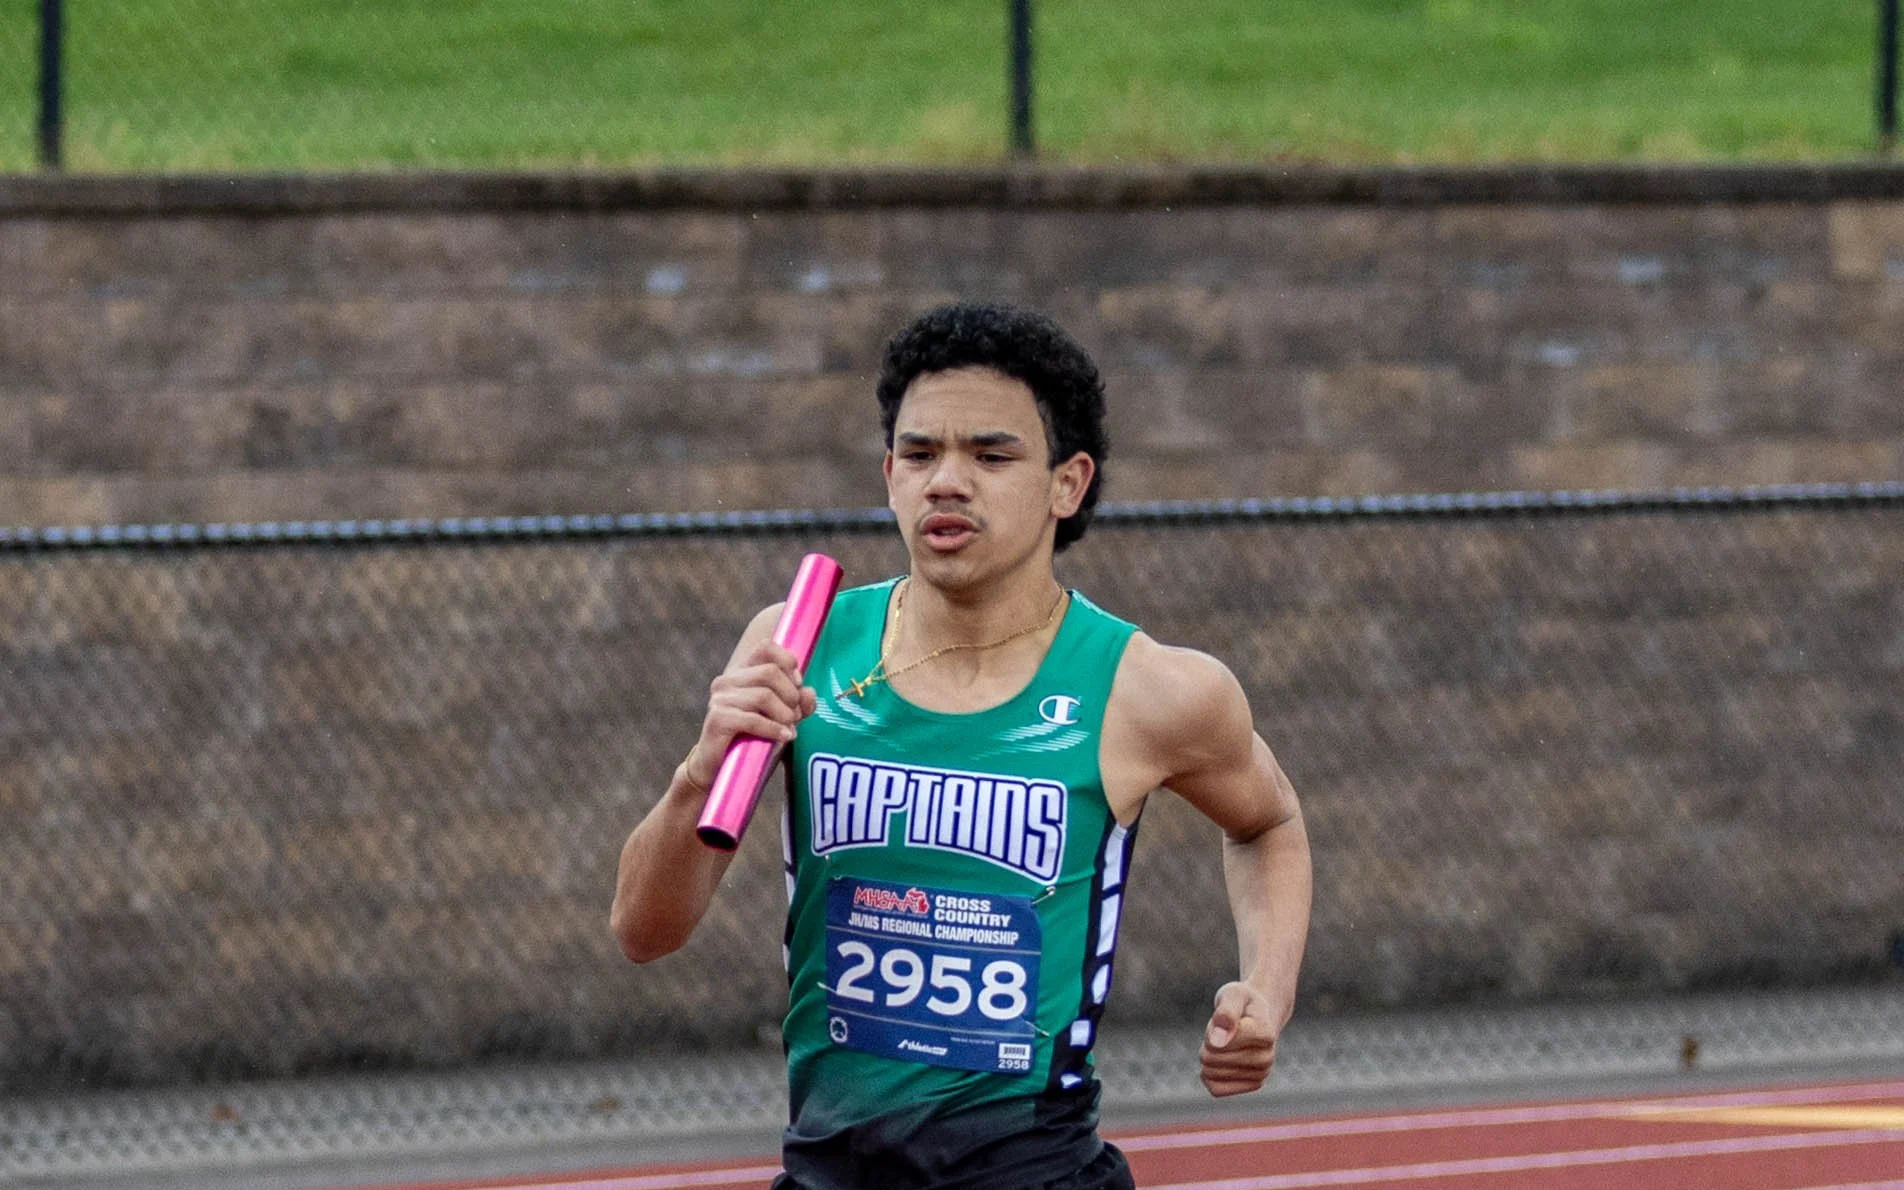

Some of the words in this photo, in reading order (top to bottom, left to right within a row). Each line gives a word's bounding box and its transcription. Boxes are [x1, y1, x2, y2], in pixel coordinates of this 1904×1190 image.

[808, 752, 1067, 884] CAPTAINS
[853, 886, 920, 914] MHSAA
[935, 895, 991, 912] CROSS
[934, 909, 1011, 927] COUNTRY
[882, 919, 932, 938] REGIONAL
[935, 925, 1019, 945] CHAMPIONSHIP
[837, 941, 1027, 1020] 2958
[998, 1059, 1030, 1070] 2958
